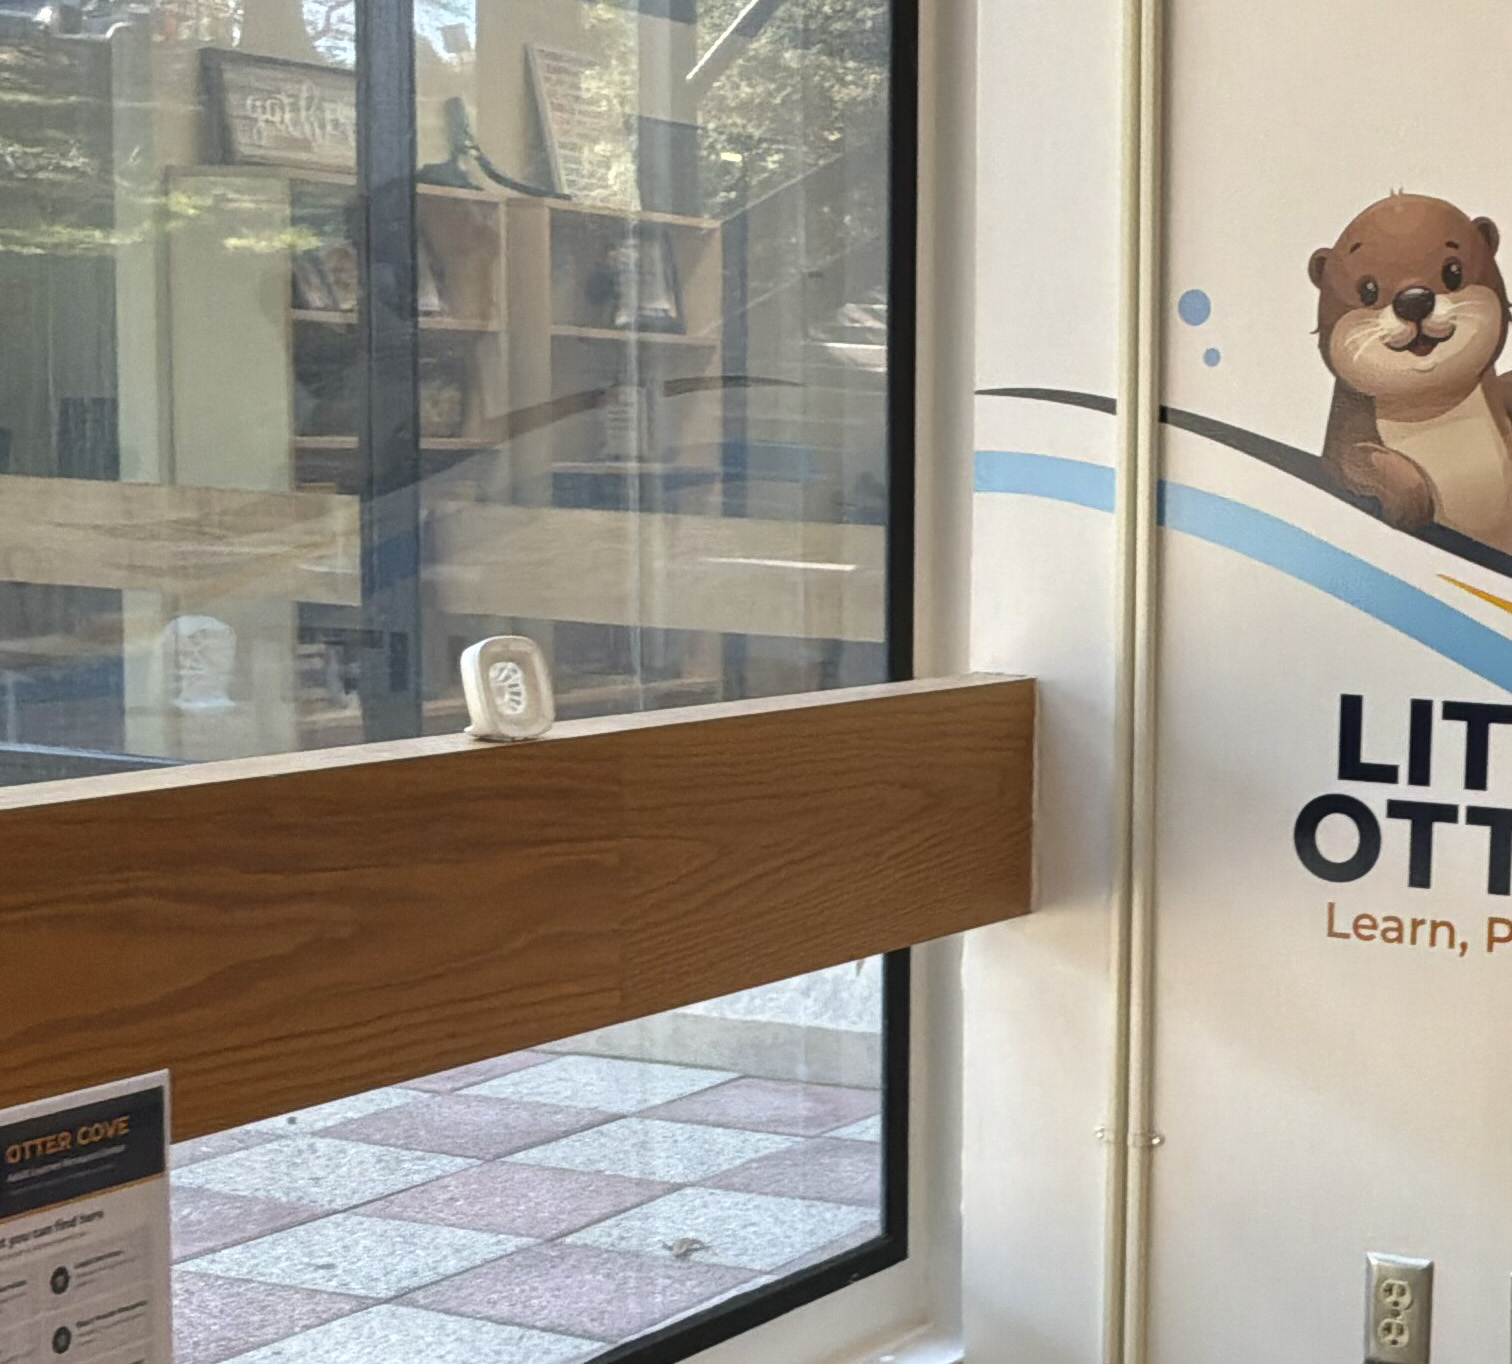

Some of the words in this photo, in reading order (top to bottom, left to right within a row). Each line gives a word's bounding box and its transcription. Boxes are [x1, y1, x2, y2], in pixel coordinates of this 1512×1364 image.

[1326, 902, 1469, 958] Learn,
[5, 1130, 72, 1164] OTTER
[76, 1115, 130, 1146] COVE
